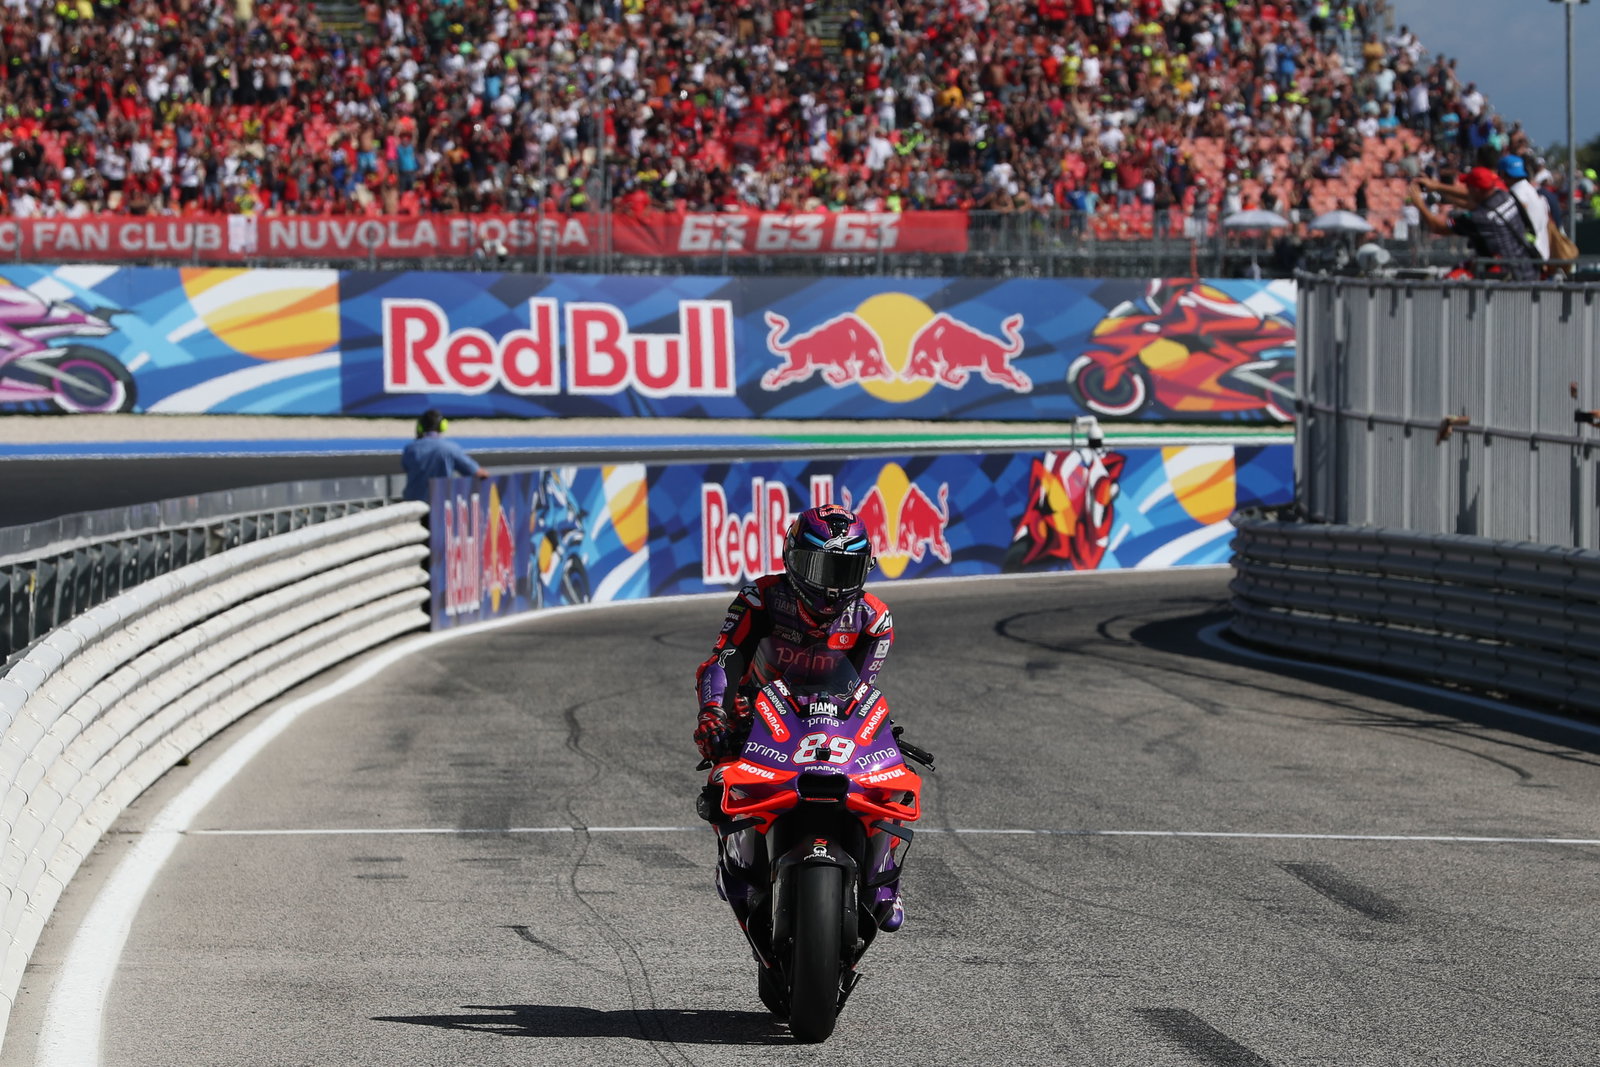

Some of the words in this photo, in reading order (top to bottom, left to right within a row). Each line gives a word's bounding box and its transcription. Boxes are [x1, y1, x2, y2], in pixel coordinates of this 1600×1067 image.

[33, 223, 109, 250] FAN
[119, 222, 221, 250] CLUB
[269, 219, 438, 248] NUVOLA
[678, 214, 749, 251] 63
[756, 213, 826, 251] 63
[832, 213, 901, 250] 63
[382, 298, 559, 394] Red
[565, 300, 735, 397] Bull
[758, 701, 785, 737] PRAMAC
[809, 701, 838, 715] FIAMM
[807, 717, 840, 728] prima
[860, 706, 886, 740] PRAMAC
[745, 741, 788, 763] prima
[792, 732, 856, 765] 89
[855, 747, 897, 770] prima
[738, 763, 776, 780] MOTUL
[804, 766, 842, 775] PRAMAC
[869, 769, 906, 783] MOTUL
[803, 853, 837, 862] PRAMAC
